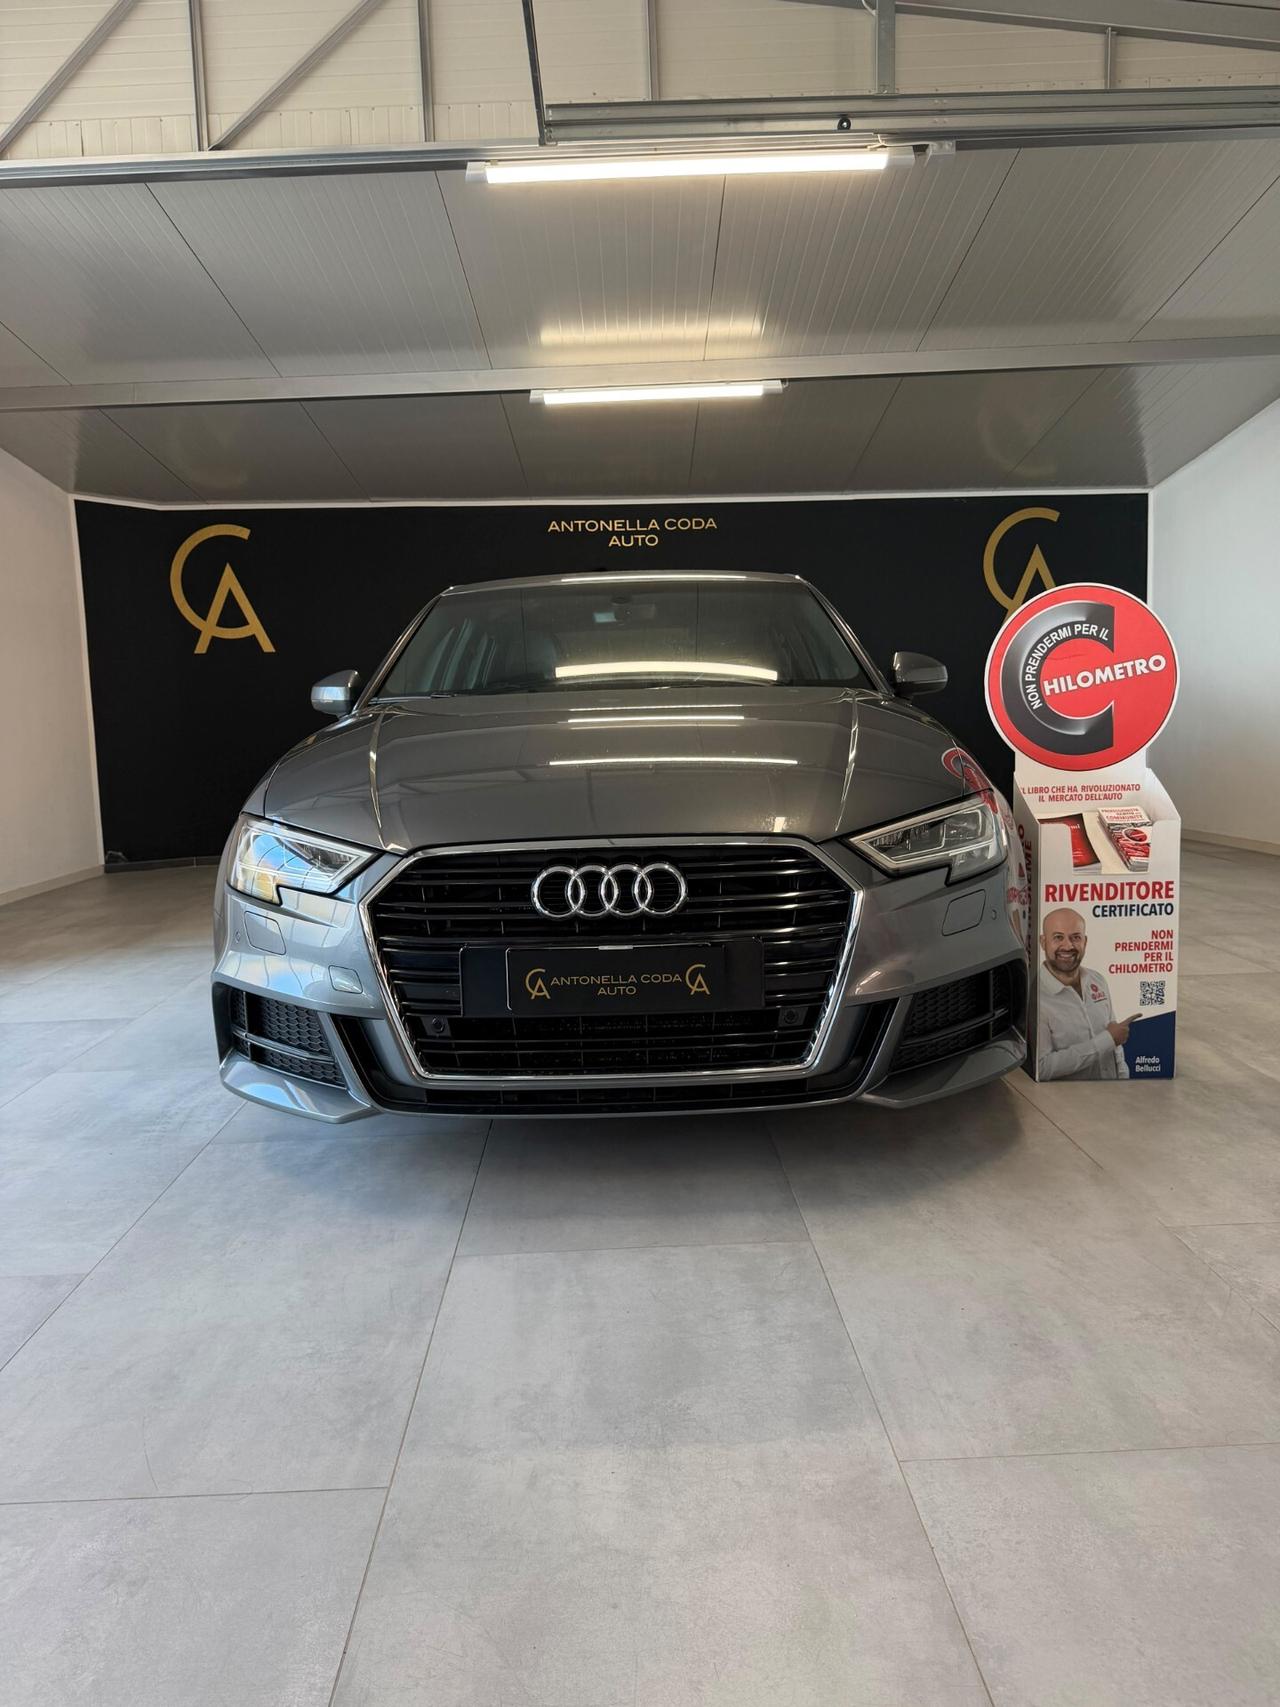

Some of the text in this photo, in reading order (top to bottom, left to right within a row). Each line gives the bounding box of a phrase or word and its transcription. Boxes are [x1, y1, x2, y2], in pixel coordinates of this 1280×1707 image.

[548, 518, 717, 532] ANTONELLA CODA
[608, 534, 659, 547] AUTO
[1025, 623, 1109, 710] NON PRENDERMI PER IL
[1028, 786, 1050, 794] LIBRO
[1051, 785, 1066, 793] CHE
[1067, 785, 1078, 793] HA
[1081, 783, 1141, 793] RIVOLUZIONATO
[1048, 794, 1083, 802] MERCATO
[1084, 793, 1123, 801] DELL'AUTO
[1044, 881, 1174, 902] RIVENDITORE
[1092, 903, 1174, 918] CERTIFICATO
[1151, 930, 1174, 940] NON
[1115, 941, 1173, 952] PRENDERMI
[1144, 952, 1174, 962] PER IL
[1108, 963, 1173, 974] CHILOMETRO
[550, 975, 637, 986] ANTONELLA
[640, 973, 682, 984] CODA
[597, 986, 637, 996] AUTO
[1135, 1056, 1160, 1064] Alfredo
